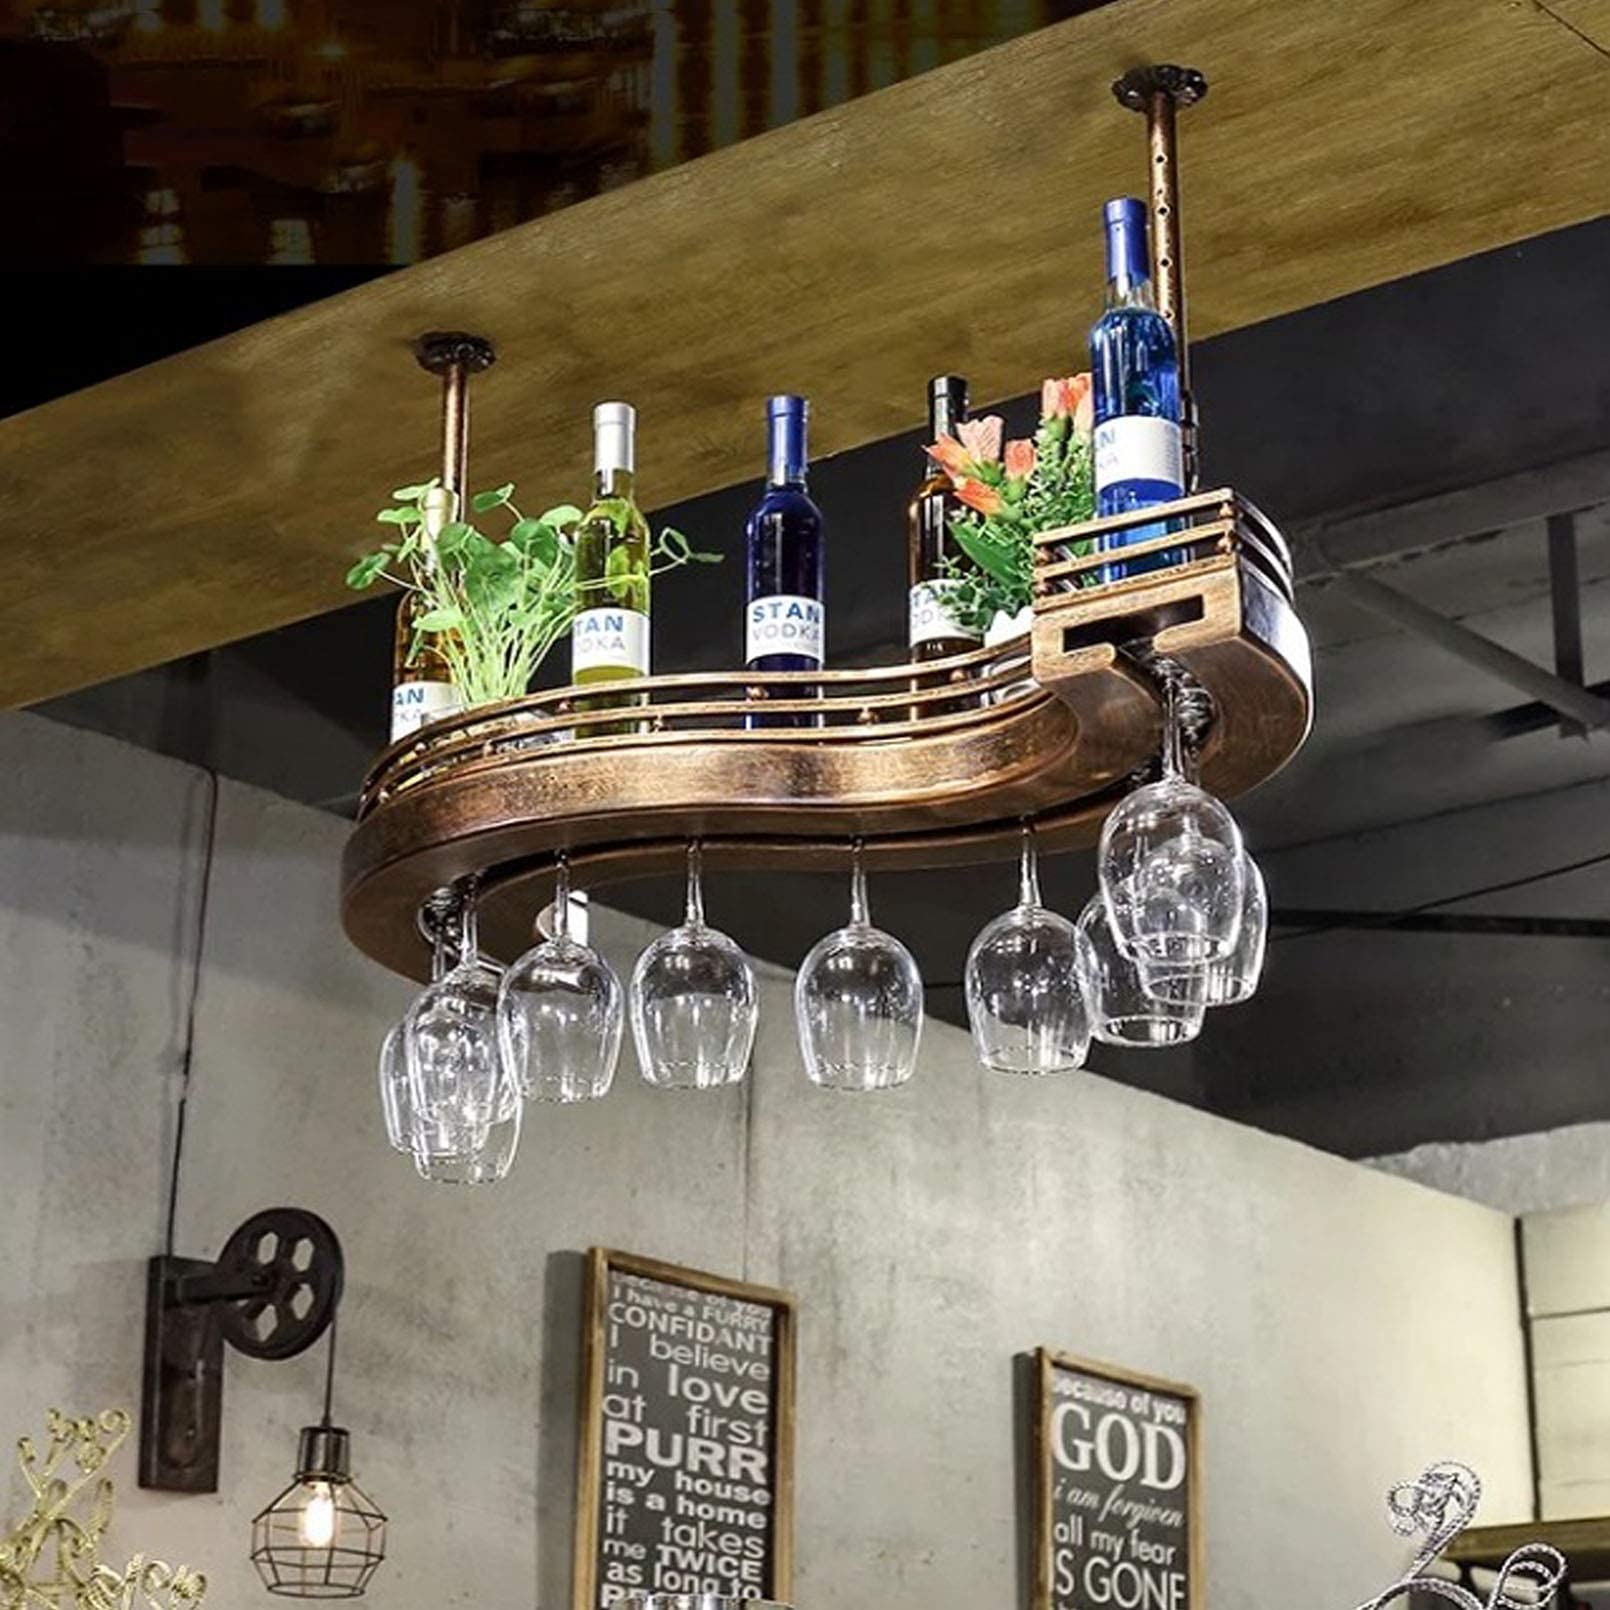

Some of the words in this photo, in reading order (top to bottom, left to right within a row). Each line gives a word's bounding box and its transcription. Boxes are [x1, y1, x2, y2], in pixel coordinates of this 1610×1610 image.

[752, 602, 820, 624] STAN
[607, 1302, 773, 1356] CONFIDANT
[613, 1285, 620, 1299] I
[627, 1286, 677, 1315] have
[702, 1304, 770, 1334] FURRY
[610, 1323, 619, 1348] I
[650, 1333, 770, 1382] believe
[607, 1358, 640, 1389] in
[667, 1363, 770, 1415] love
[1130, 1392, 1151, 1415] of
[1152, 1400, 1187, 1425] you
[602, 1394, 647, 1423] at
[686, 1404, 769, 1447] first
[604, 1419, 769, 1486] PURR
[1051, 1402, 1187, 1491] GOD
[606, 1460, 656, 1488] my
[674, 1470, 771, 1506] house
[606, 1481, 635, 1505] is
[644, 1492, 666, 1512] a
[677, 1495, 768, 1529] home
[1066, 1485, 1100, 1510] am
[1098, 1483, 1185, 1530] forgiven
[606, 1505, 629, 1535] it
[661, 1516, 766, 1560] takes
[1053, 1514, 1083, 1547] all
[1090, 1529, 1125, 1562] my
[1131, 1528, 1176, 1566] fear
[603, 1538, 647, 1560] me
[655, 1544, 763, 1583] TWICE
[606, 1561, 643, 1585] as
[653, 1562, 720, 1594] long
[729, 1578, 762, 1599] to
